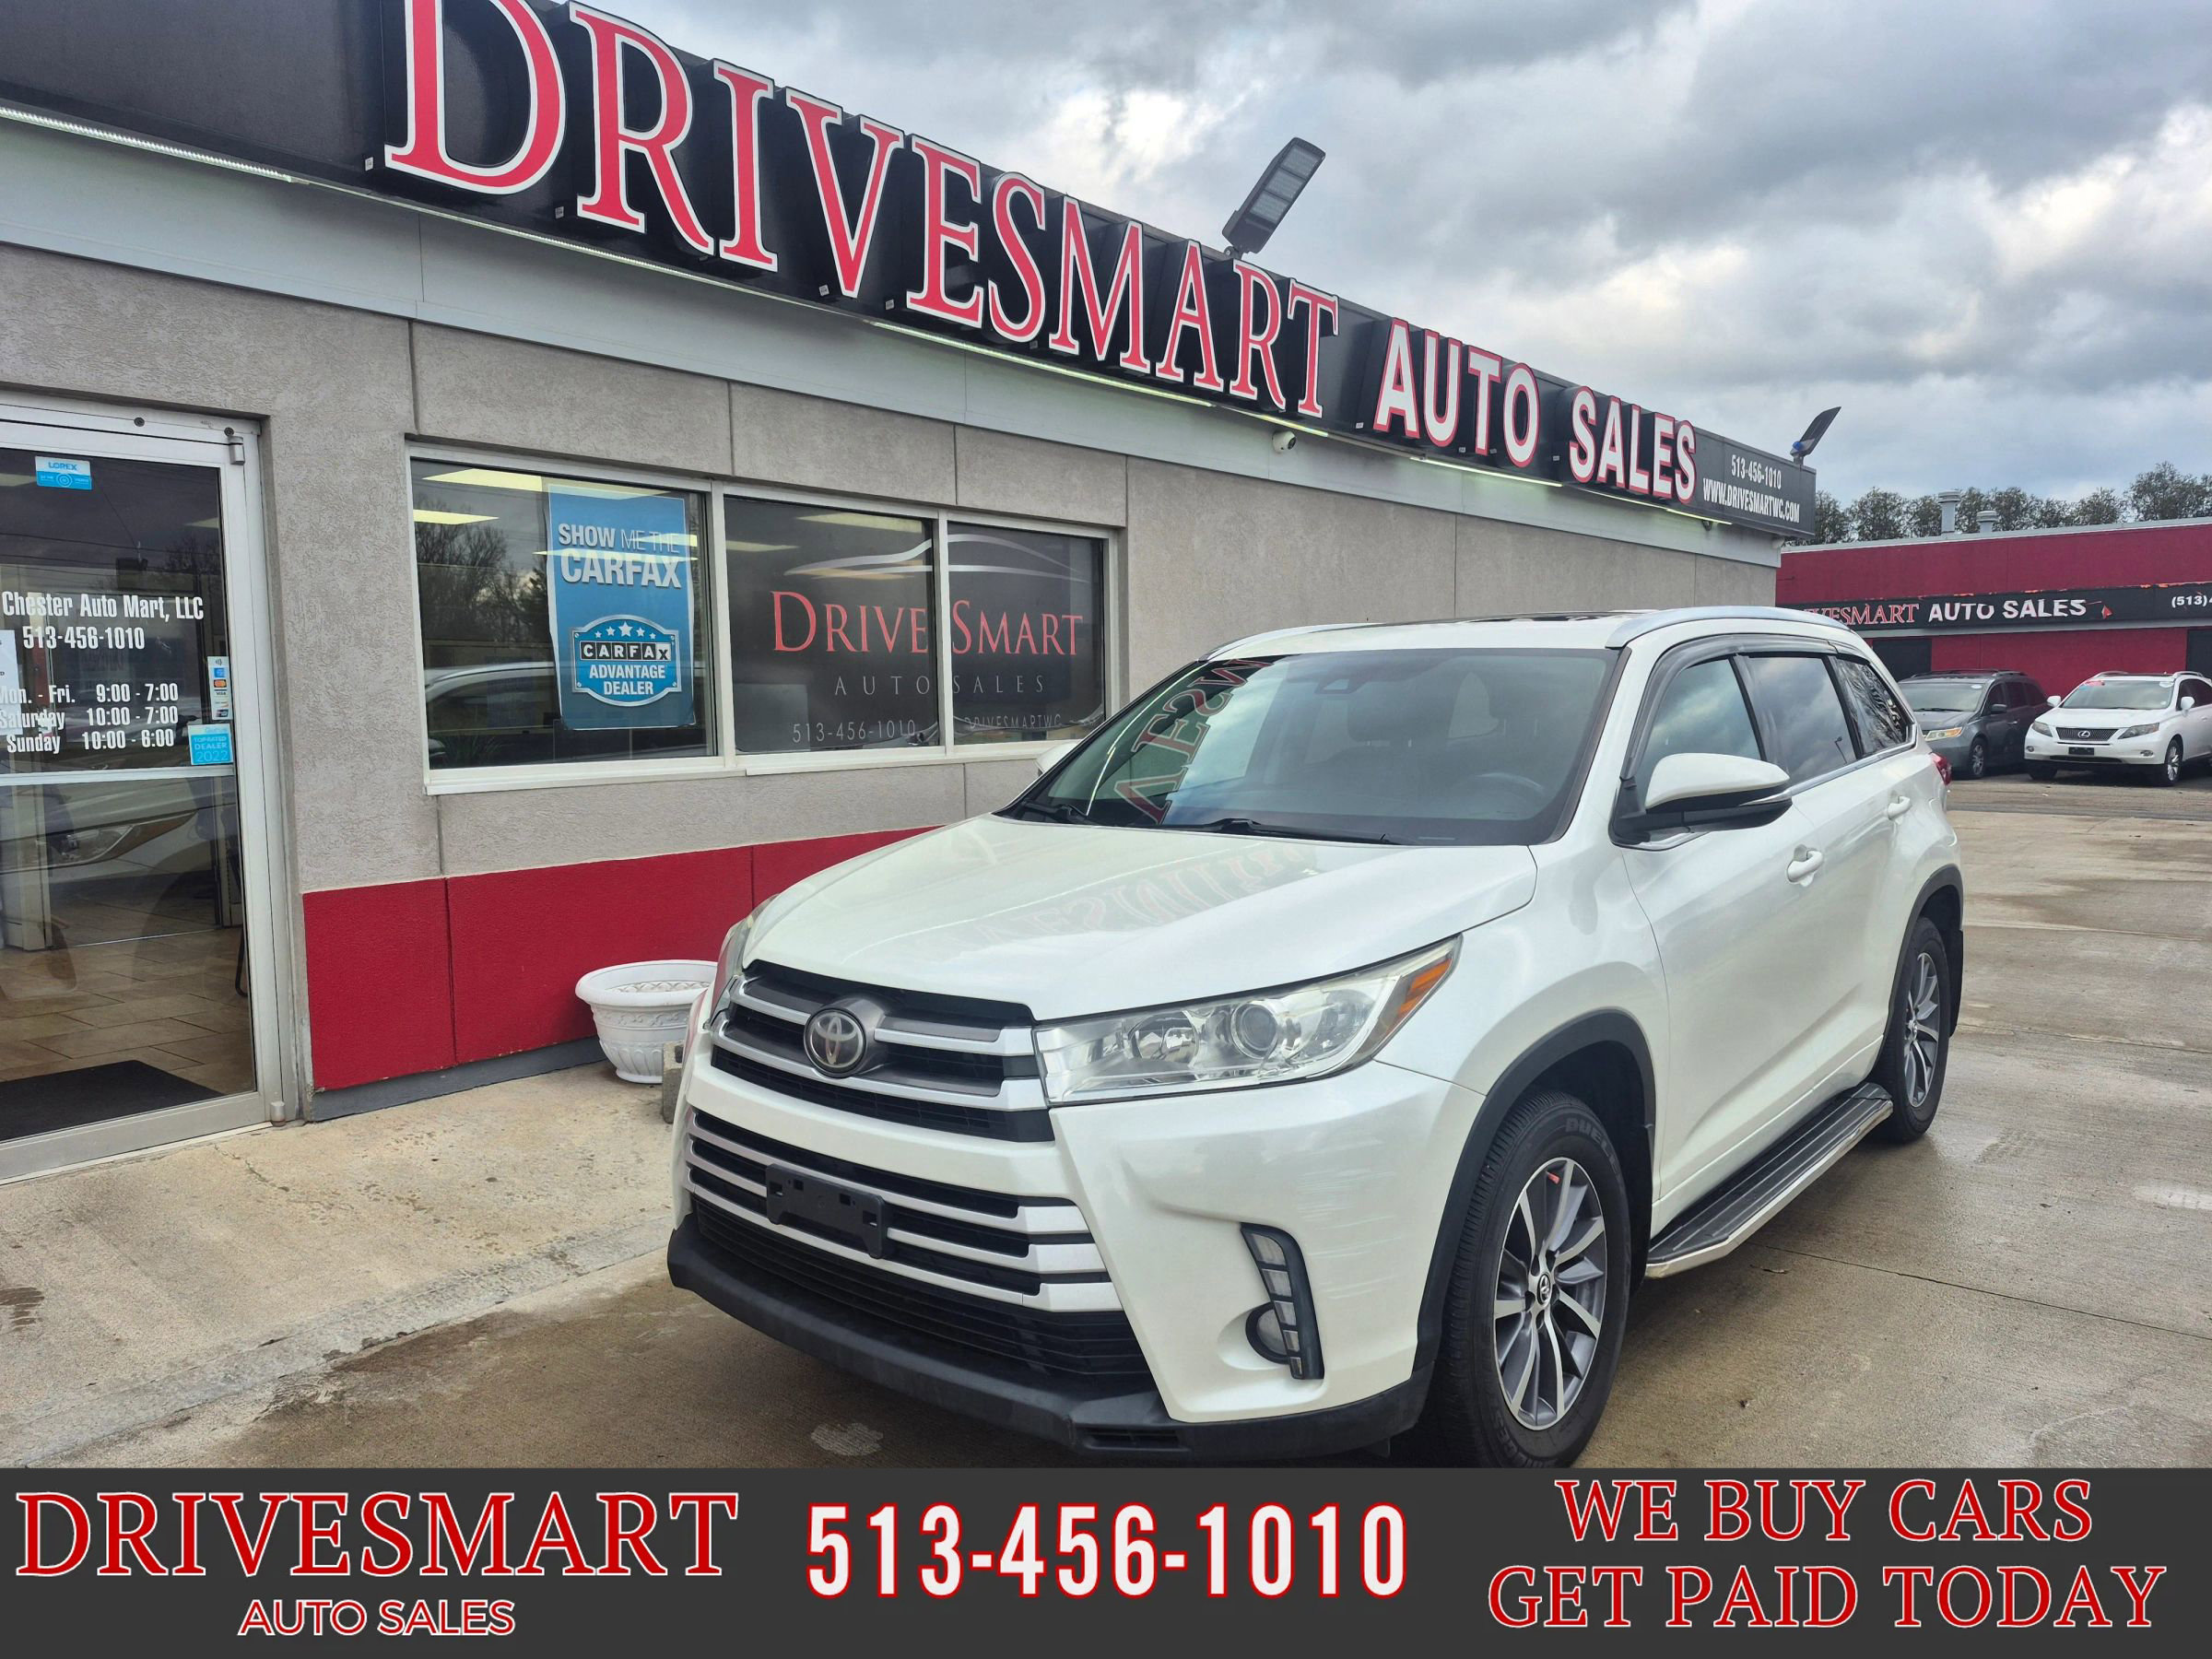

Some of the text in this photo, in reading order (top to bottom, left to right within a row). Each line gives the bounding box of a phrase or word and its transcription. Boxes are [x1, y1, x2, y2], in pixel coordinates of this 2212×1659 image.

[383, 0, 1696, 504] DRIVESMART AUTO SALES
[1731, 454, 1782, 489] 513-456-1010
[1703, 477, 1800, 524] WWW.DRIVESMARTWC.COM
[559, 523, 679, 553] SHOW ME THE
[560, 547, 682, 588] CARFAX
[2, 591, 204, 622] Chester Auto Mart, LLC
[1928, 603, 1994, 622] AUTO
[2003, 599, 2087, 619] SALES
[770, 591, 1084, 656] DRIVE SMART
[22, 626, 145, 650] 513-456-1010
[583, 643, 669, 660] CARFAX
[589, 665, 666, 678] ADVANTAGE
[49, 685, 76, 703] Fri.
[96, 684, 131, 702] 9:00
[145, 683, 179, 701] 7:00
[604, 681, 653, 695] DEALER
[834, 674, 1044, 696] AUTO SALES
[0, 708, 65, 730] Saturday
[87, 707, 131, 725] 10:00
[145, 706, 179, 724] 7:00
[6, 734, 61, 754] Sunday
[82, 731, 126, 750] 10:00
[141, 729, 175, 748] 6:00
[793, 719, 915, 743] 513-456-1010
[195, 750, 229, 762] 2022
